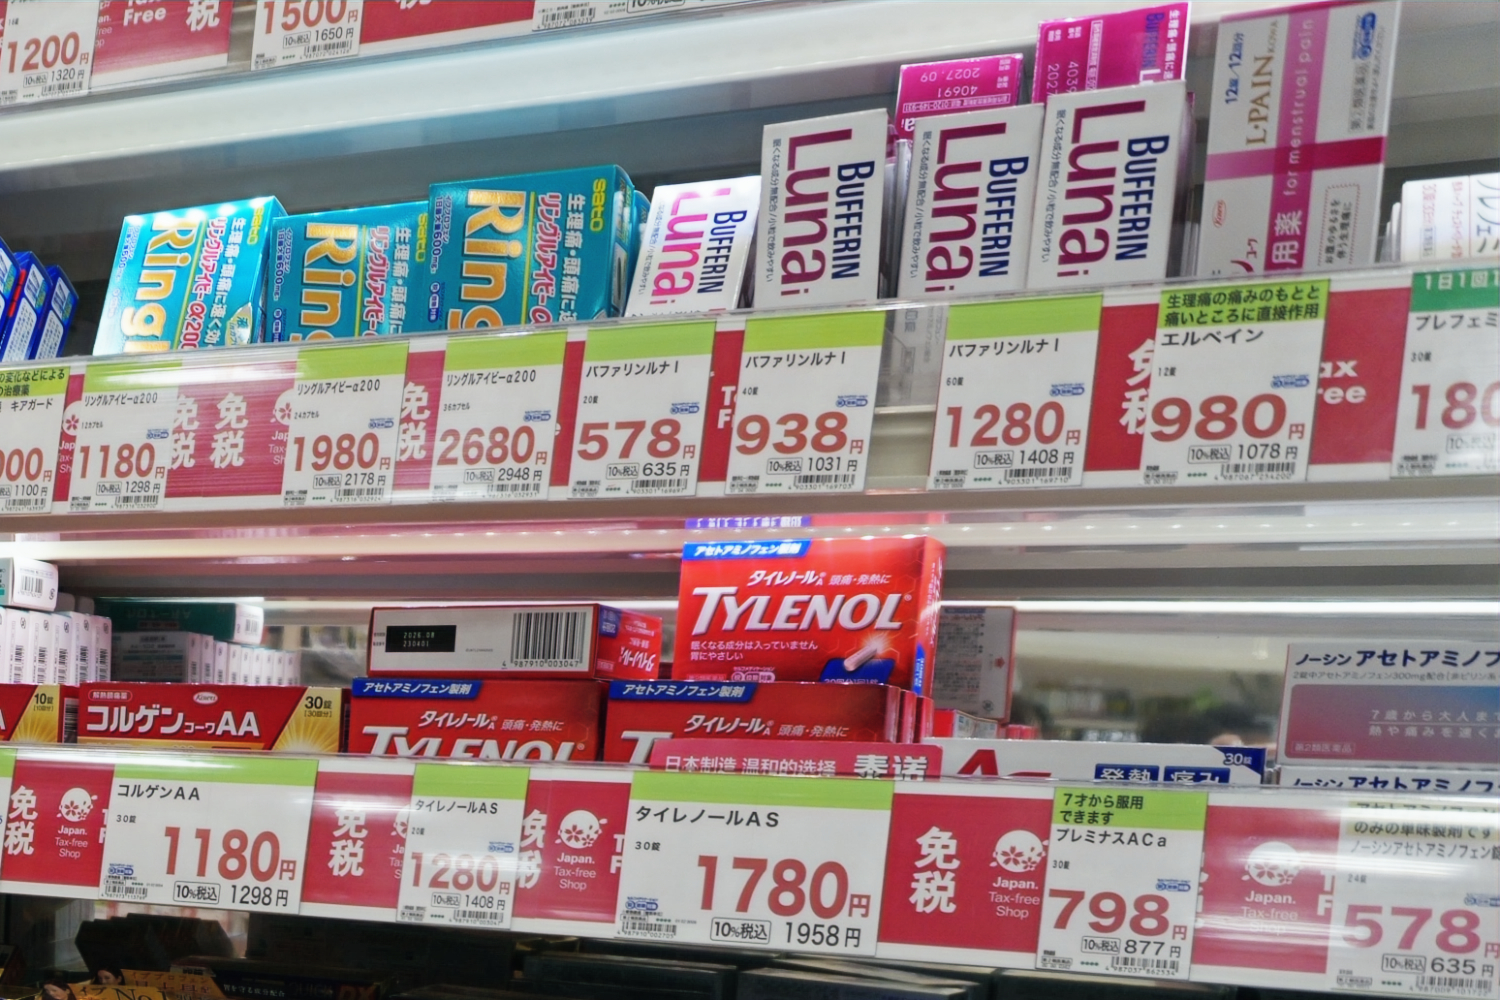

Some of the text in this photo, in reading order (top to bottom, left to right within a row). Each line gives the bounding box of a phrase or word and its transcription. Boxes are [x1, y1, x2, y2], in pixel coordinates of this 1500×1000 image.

[831, 160, 875, 280] BUFFERIN
[979, 156, 1029, 278] BUFFERIN
[1115, 134, 1170, 261] BUFFERIN
[1164, 303, 1319, 327] 痛いところに直接作用
[1166, 284, 1320, 310] 生理痛の痛みのもとと
[690, 586, 903, 637] TYLENOL
[622, 684, 745, 698] アセトアミノフェン製剤
